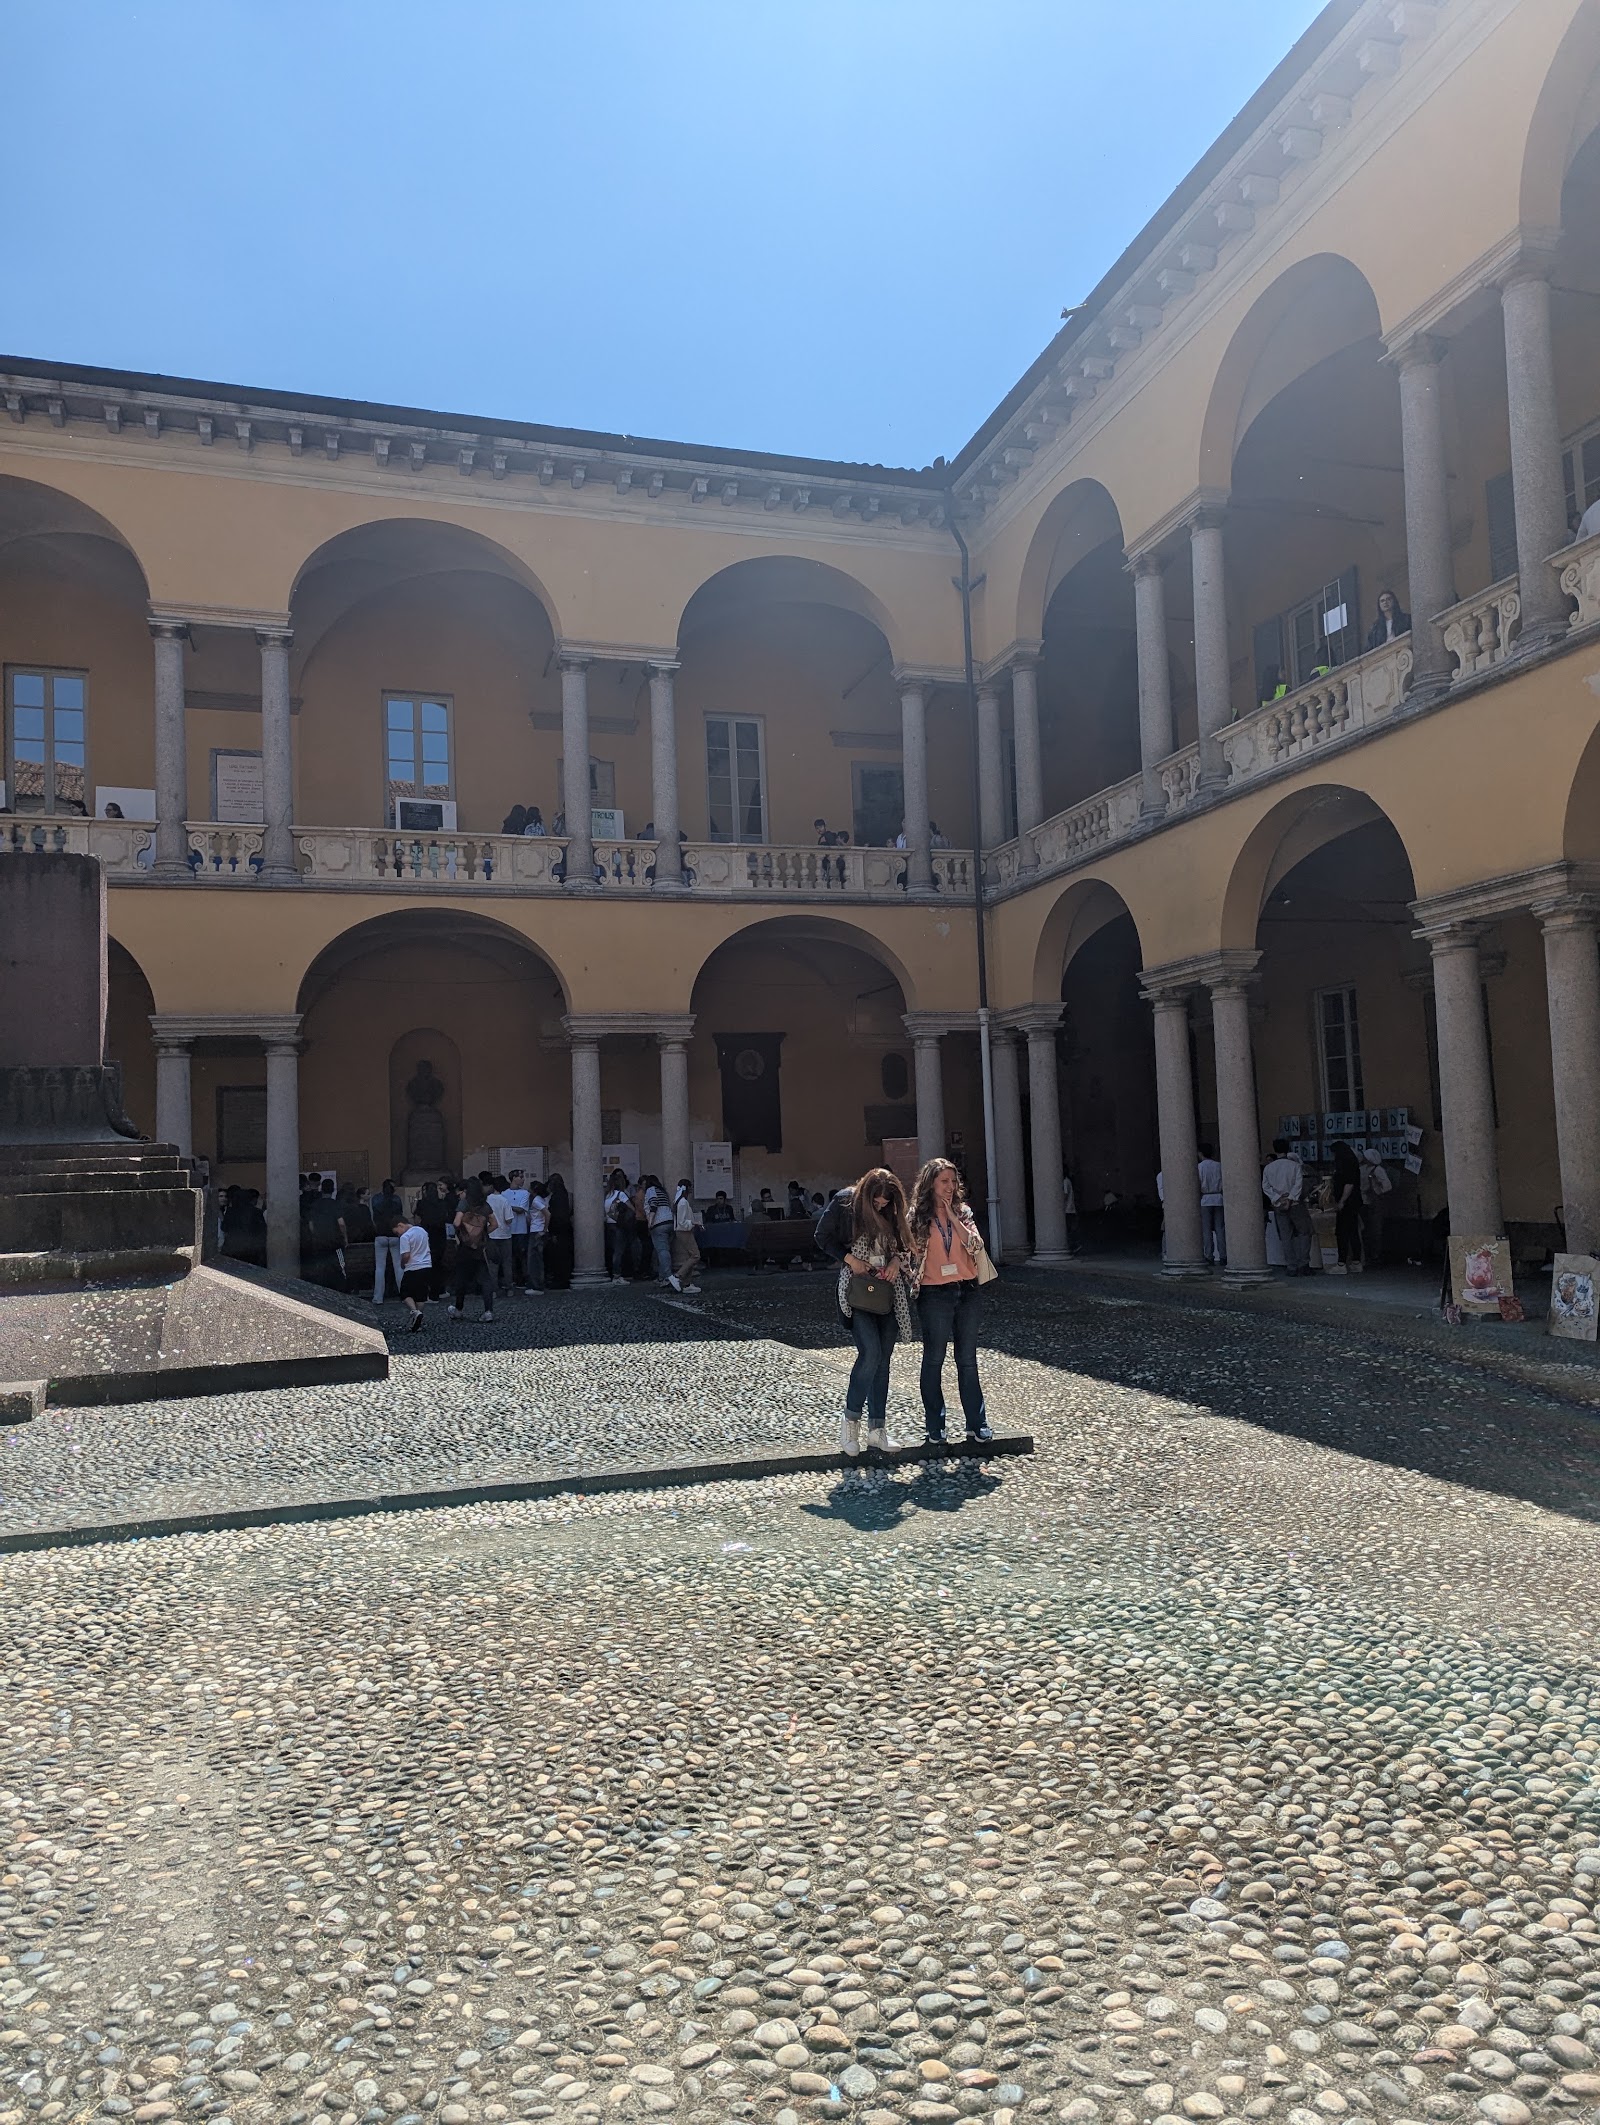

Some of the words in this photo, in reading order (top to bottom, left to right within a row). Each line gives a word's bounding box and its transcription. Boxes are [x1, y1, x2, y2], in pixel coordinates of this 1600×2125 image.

[1284, 1120, 1299, 1132] UN
[1309, 1115, 1379, 1131] SOFFIO
[1390, 1113, 1405, 1126] DI
